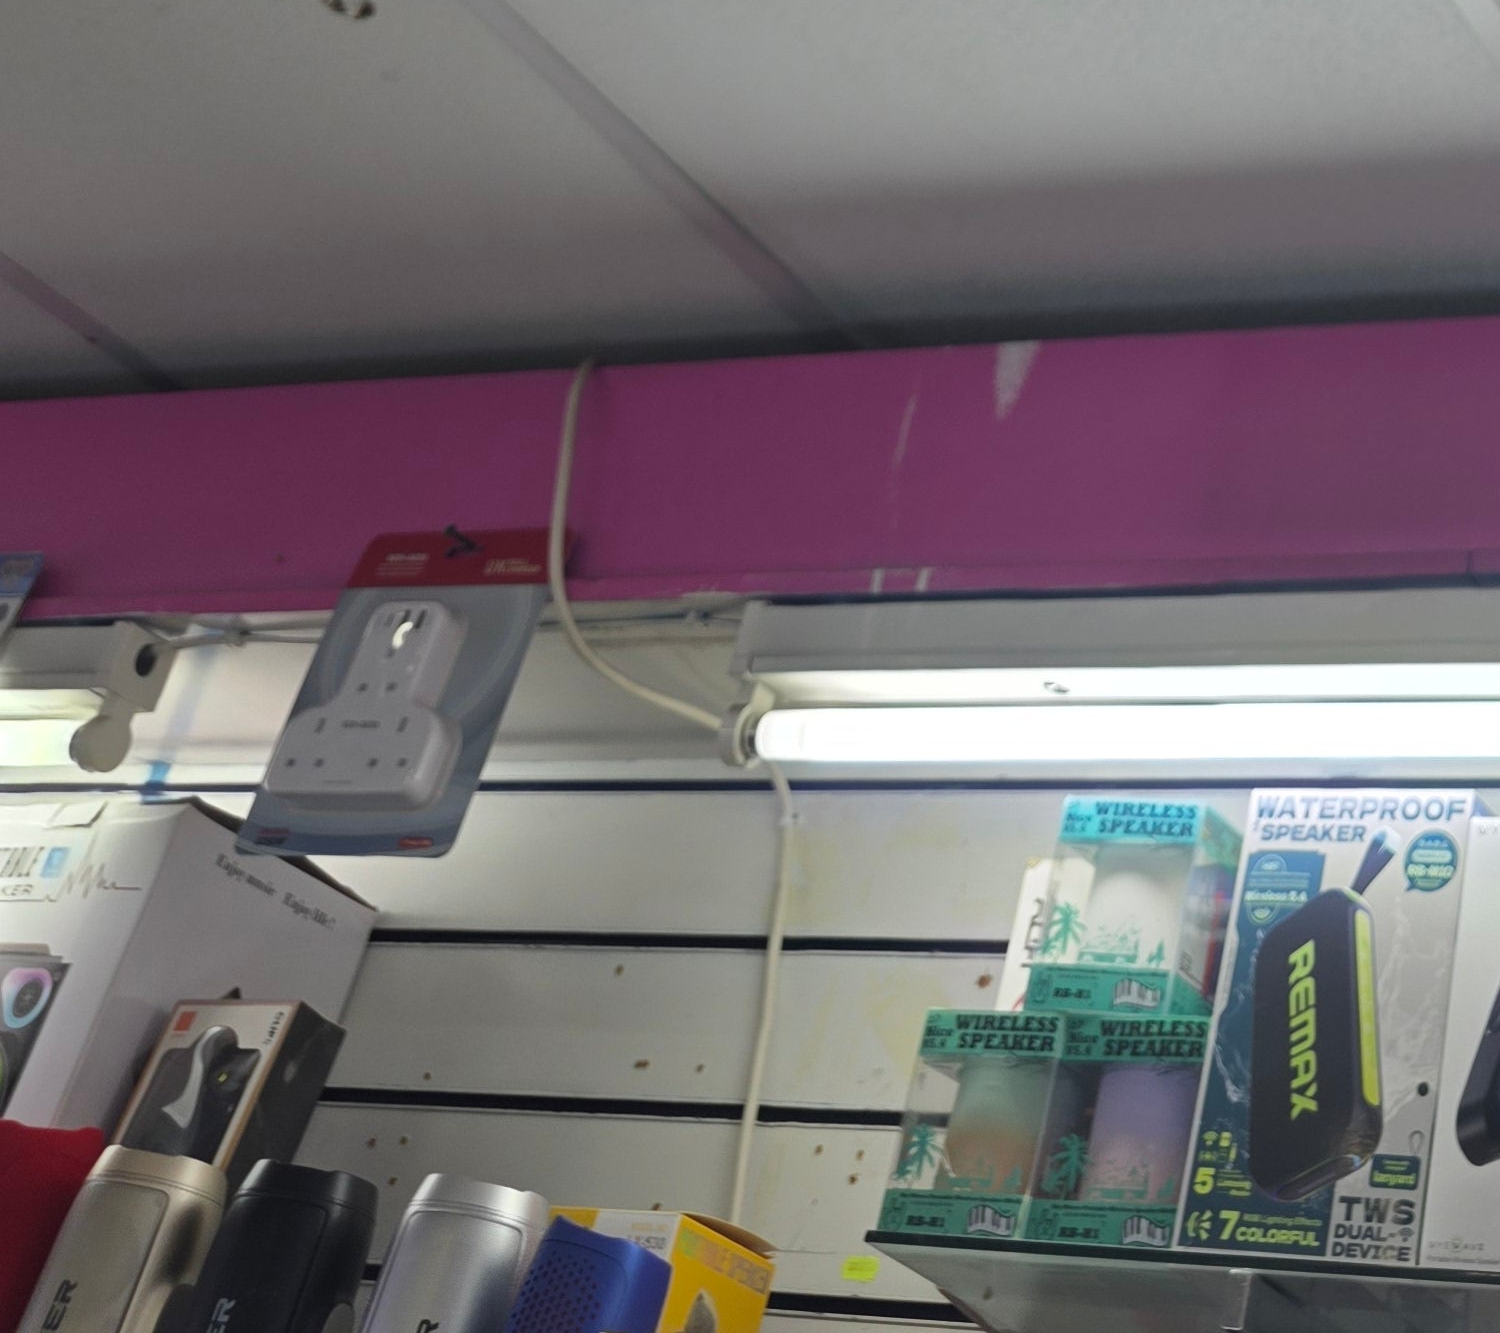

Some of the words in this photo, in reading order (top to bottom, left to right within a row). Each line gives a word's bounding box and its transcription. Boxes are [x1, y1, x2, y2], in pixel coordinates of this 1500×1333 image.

[1095, 801, 1198, 819] WIRELESS
[1257, 795, 1467, 821] WATERPROOF
[1098, 819, 1194, 837] SPEAKER
[1261, 824, 1367, 842] SPEAKER
[956, 1014, 1059, 1033] WIRELESS
[1100, 1019, 1208, 1038] WIRELESS
[1288, 939, 1318, 1121] REMAX
[957, 1032, 1056, 1051] SPEAKER
[1103, 1039, 1203, 1057] SPEAKER
[1192, 1167, 1216, 1194] 5
[1339, 1196, 1416, 1225] TWS
[1219, 1210, 1240, 1240] 7
[1236, 1226, 1321, 1247] COLORFUL
[1331, 1242, 1411, 1262] DEVICE
